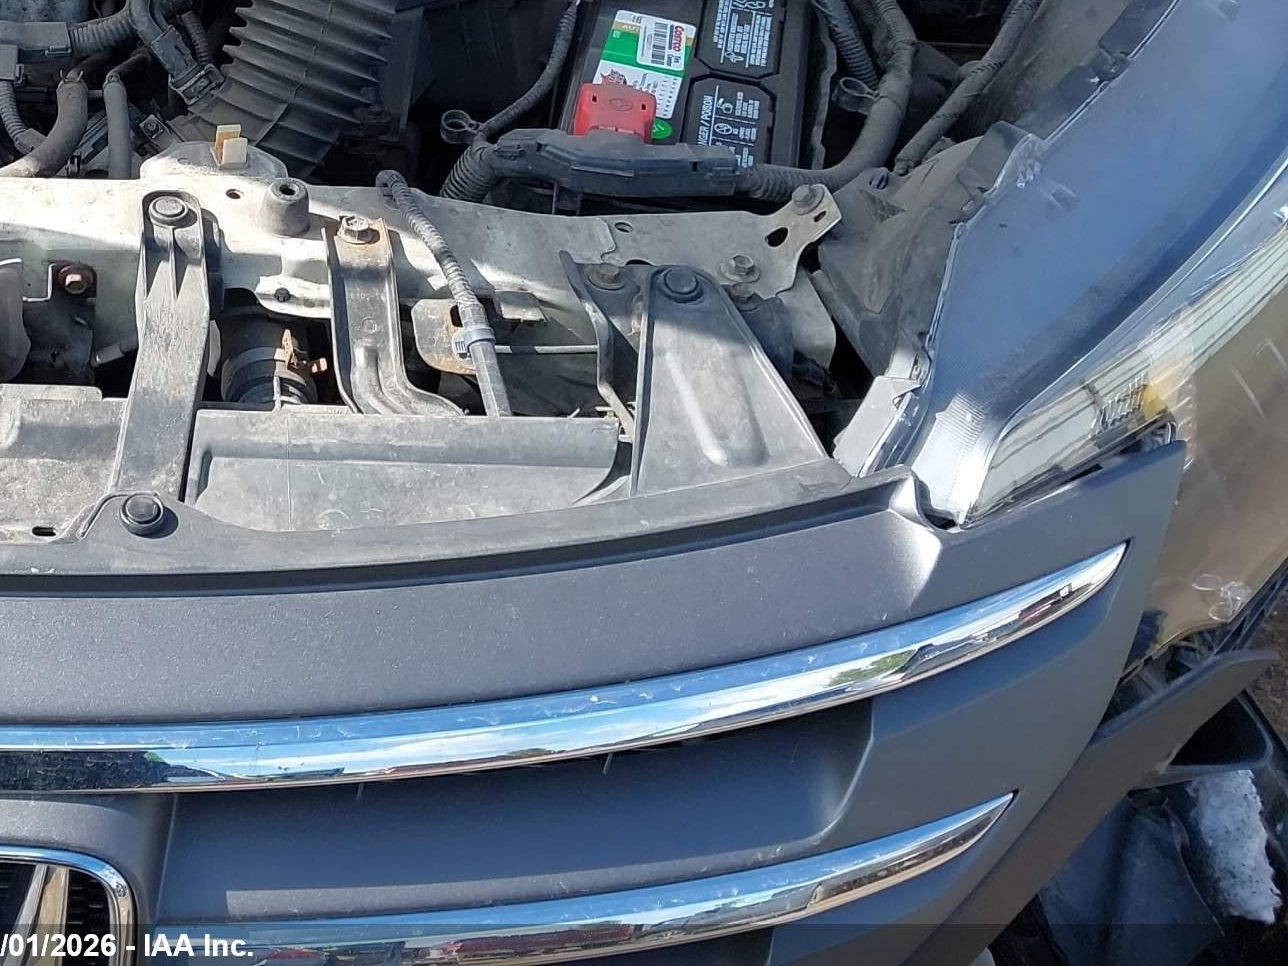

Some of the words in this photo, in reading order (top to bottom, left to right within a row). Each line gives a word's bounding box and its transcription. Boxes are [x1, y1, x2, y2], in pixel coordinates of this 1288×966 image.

[672, 25, 685, 52] COSTCO
[700, 94, 714, 121] POISON
[696, 125, 710, 146] NGER
